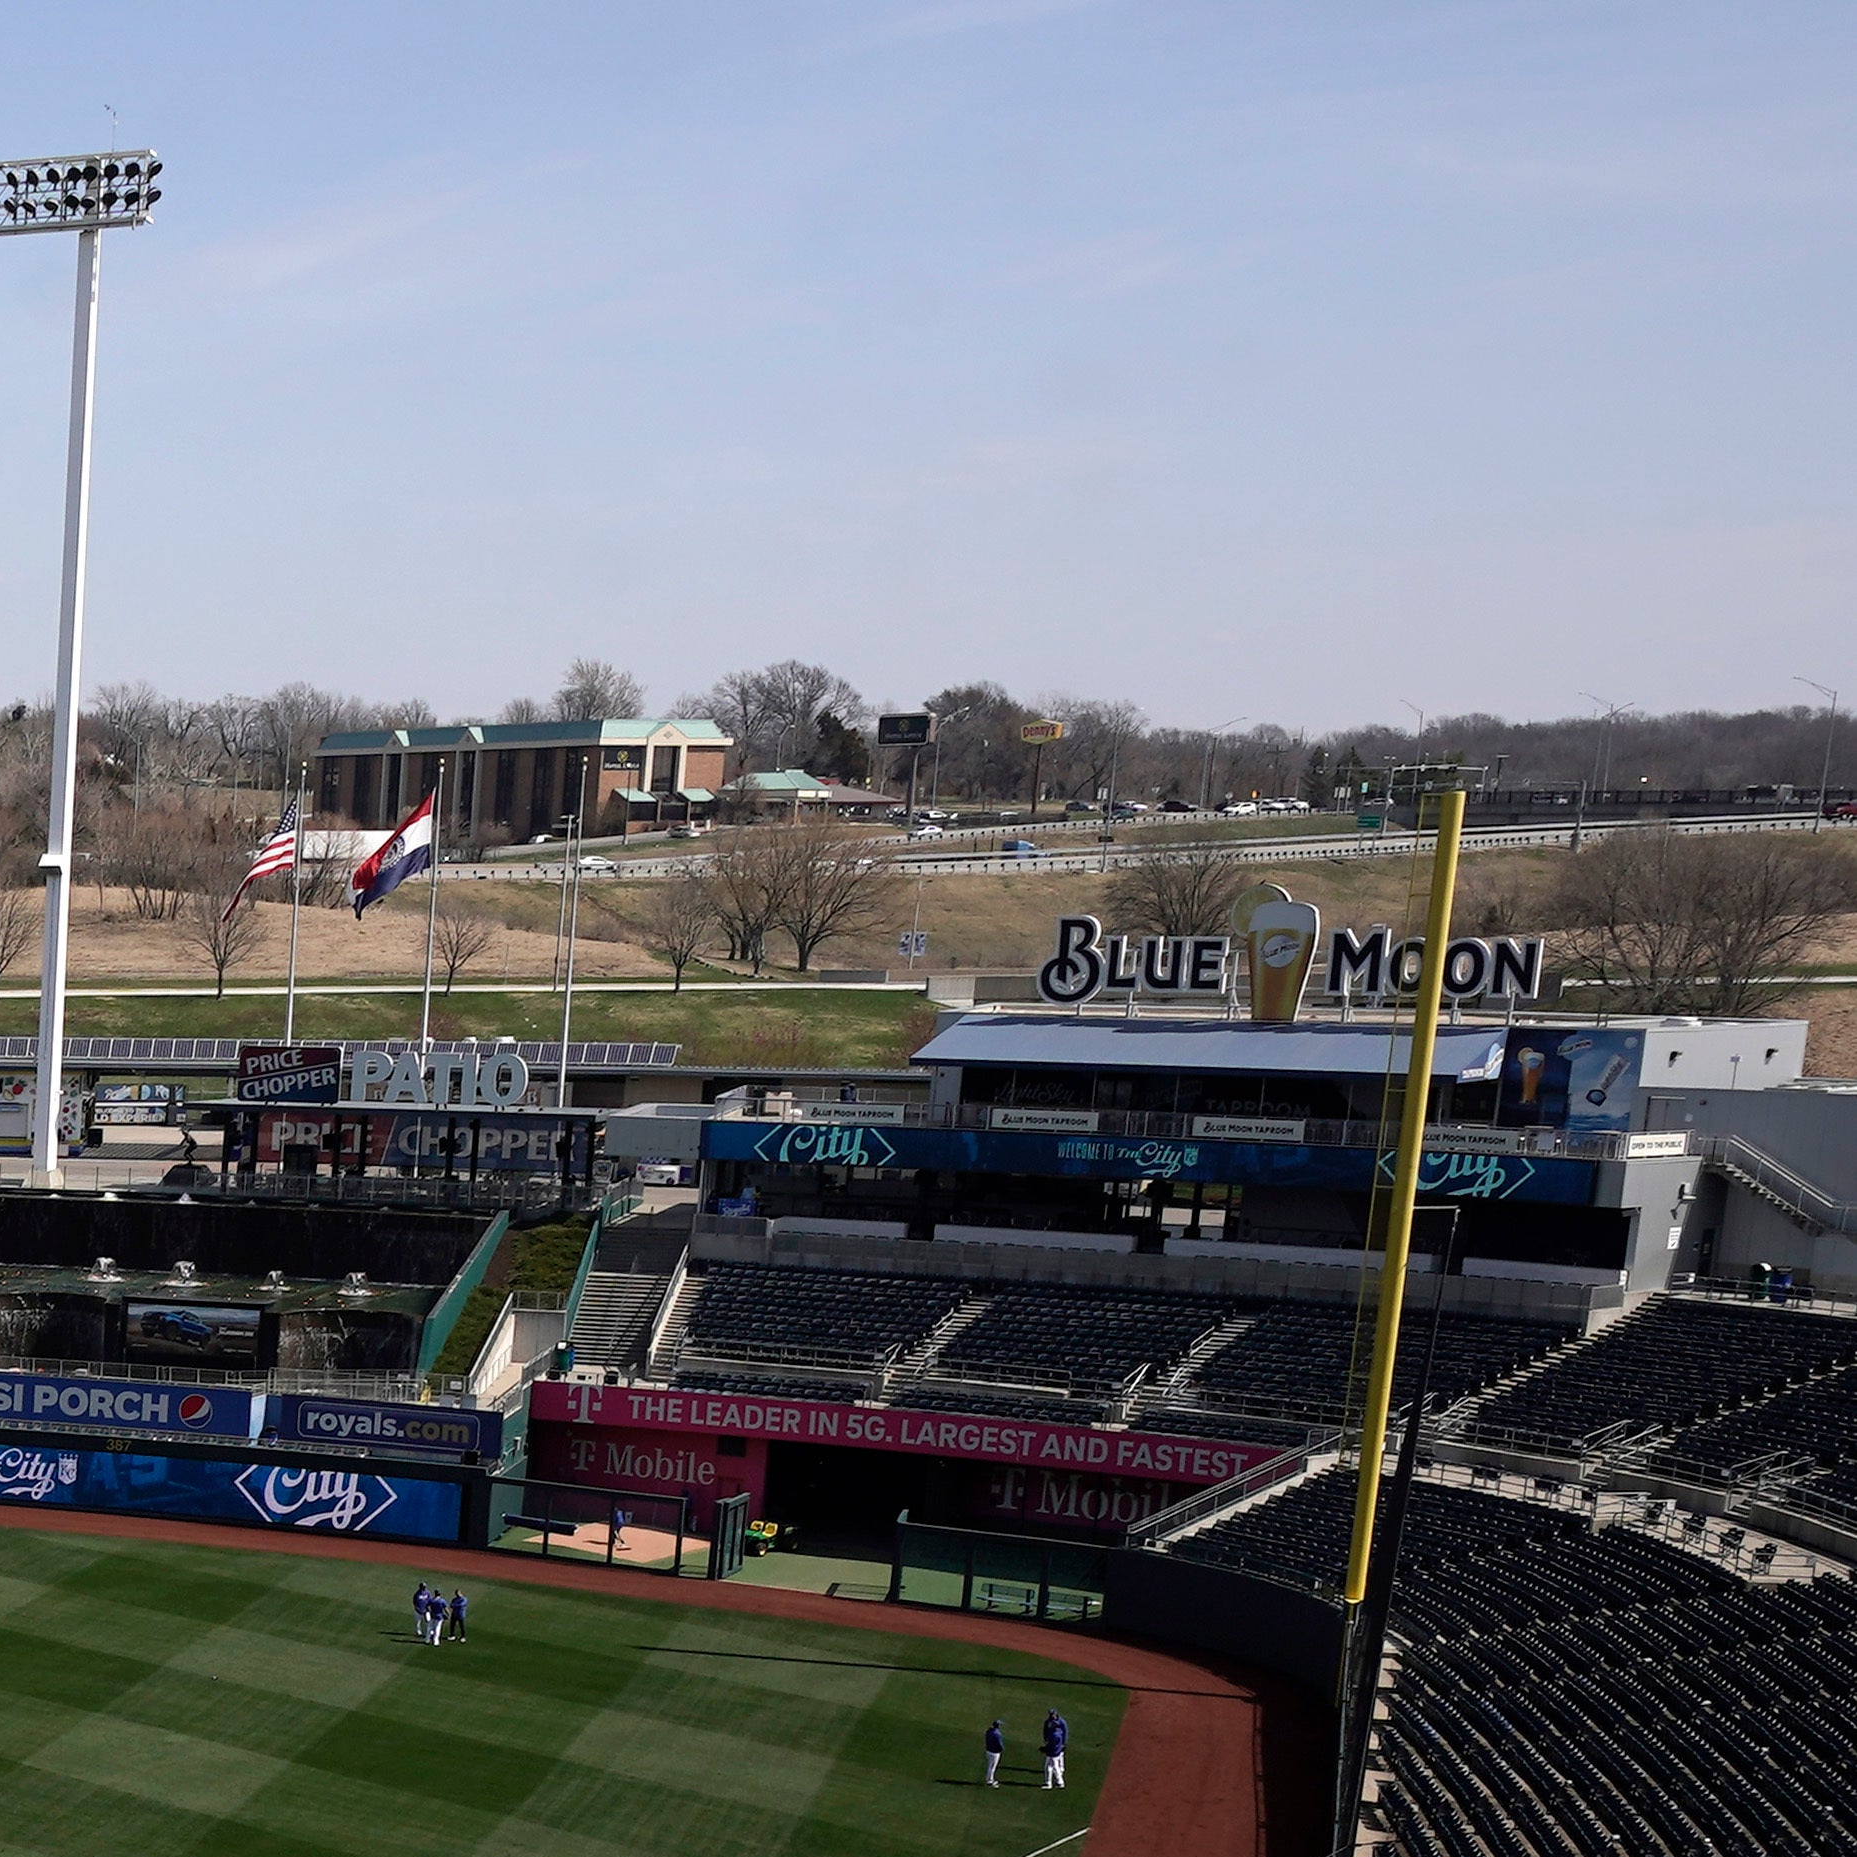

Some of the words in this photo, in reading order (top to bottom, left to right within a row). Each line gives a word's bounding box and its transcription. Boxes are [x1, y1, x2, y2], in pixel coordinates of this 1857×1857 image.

[1023, 724, 1056, 739] Denny's
[1039, 916, 1229, 1002] BLUE
[1325, 925, 1543, 999] MOON
[245, 1049, 304, 1076] PRICE
[351, 1051, 528, 1105] PATIO
[242, 1069, 336, 1099] CHOPPER
[811, 1106, 831, 1119] BLUE
[833, 1108, 856, 1119] MOON
[858, 1109, 895, 1120] TAPROOM
[1001, 1113, 1023, 1126] BLUE
[1025, 1115, 1049, 1126] MOON
[1051, 1117, 1089, 1127] TAPROOM
[1203, 1121, 1227, 1133] BLUE
[1228, 1123, 1253, 1133] MOON
[1254, 1125, 1294, 1135] TAPROOM
[779, 1126, 869, 1167] City
[1423, 1133, 1440, 1142] LUE
[1442, 1133, 1467, 1144] MOON
[1467, 1135, 1507, 1145] TAPROOM
[1057, 1142, 1100, 1160] WELCOME
[1102, 1143, 1114, 1161] TO
[1135, 1141, 1183, 1178] City
[32, 1385, 169, 1423] PORCH
[306, 1408, 471, 1444] royals.com
[628, 1395, 684, 1424] THE
[690, 1398, 800, 1435] LEADER
[808, 1411, 839, 1437] IN
[846, 1414, 893, 1443] 5G.
[900, 1423, 1037, 1457] LARGEST
[1039, 1436, 1110, 1464] AND
[1117, 1441, 1249, 1480] FASTEST
[106, 1438, 132, 1452] 387
[604, 1443, 716, 1486] Mobile
[262, 1464, 368, 1531] City
[1036, 1470, 1171, 1525] Mobil
